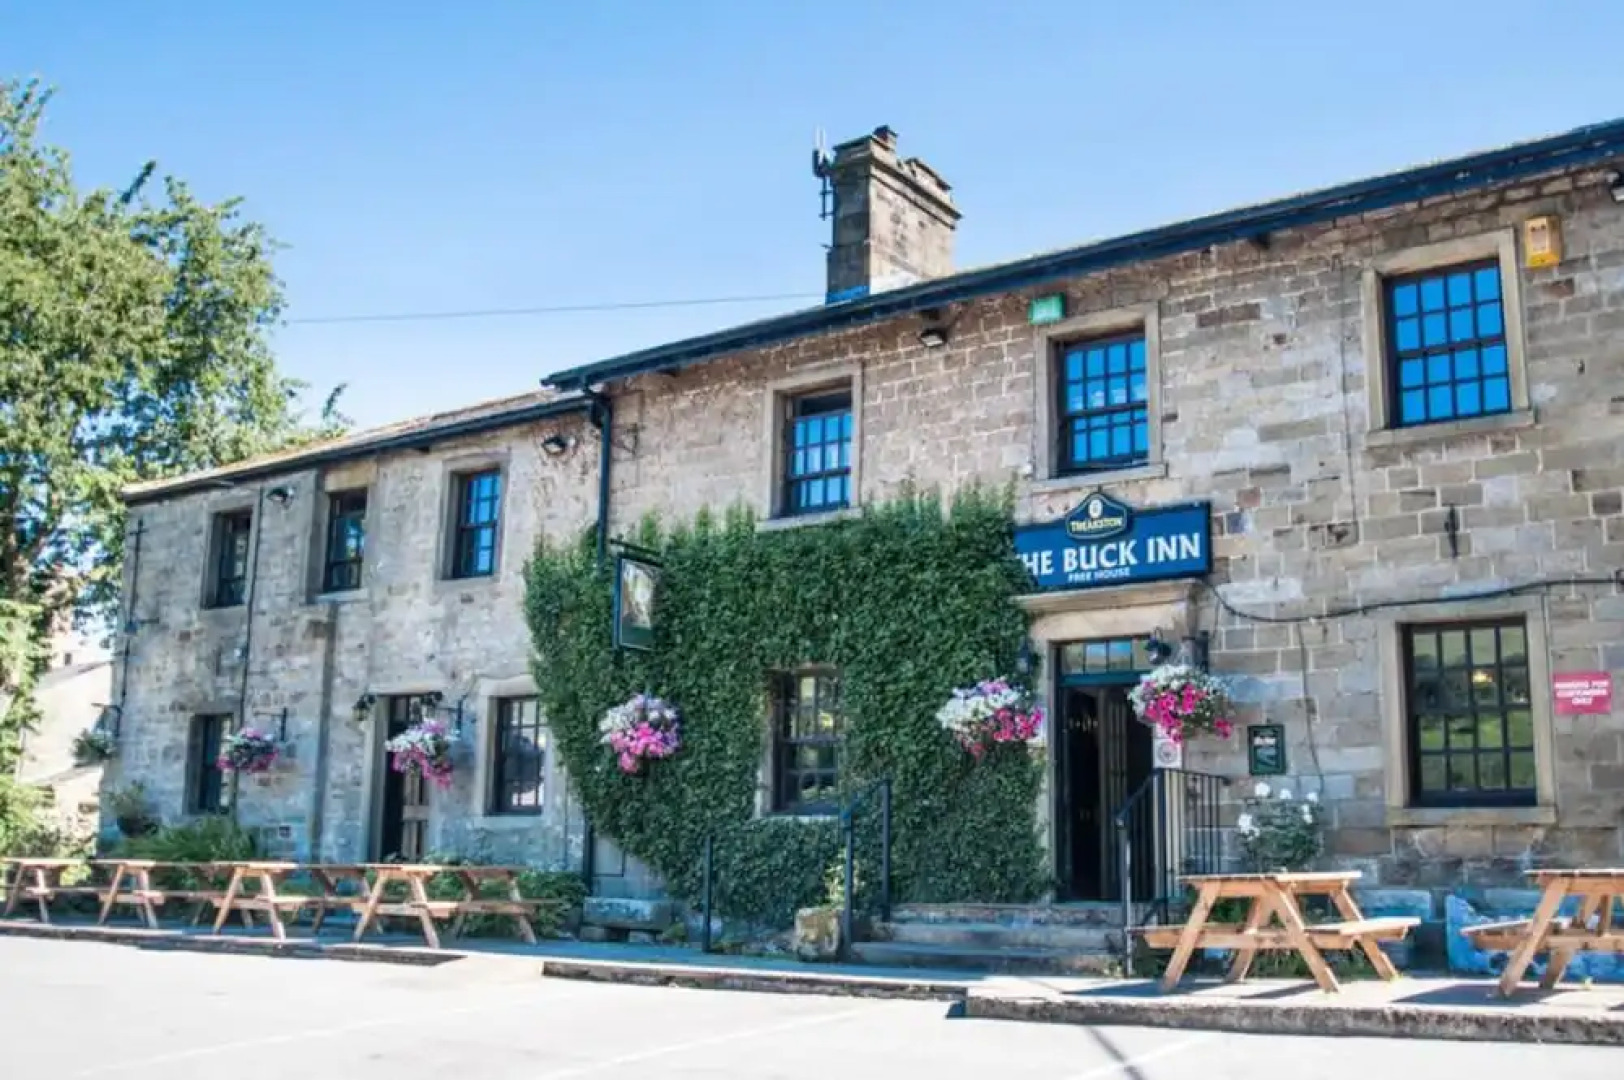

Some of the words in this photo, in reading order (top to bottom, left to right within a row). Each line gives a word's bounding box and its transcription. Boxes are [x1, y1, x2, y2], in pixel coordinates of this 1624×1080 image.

[1016, 550, 1054, 575] HE
[1063, 539, 1137, 573] BUCK
[1147, 533, 1200, 563] INN
[1094, 567, 1130, 580] HOUSE
